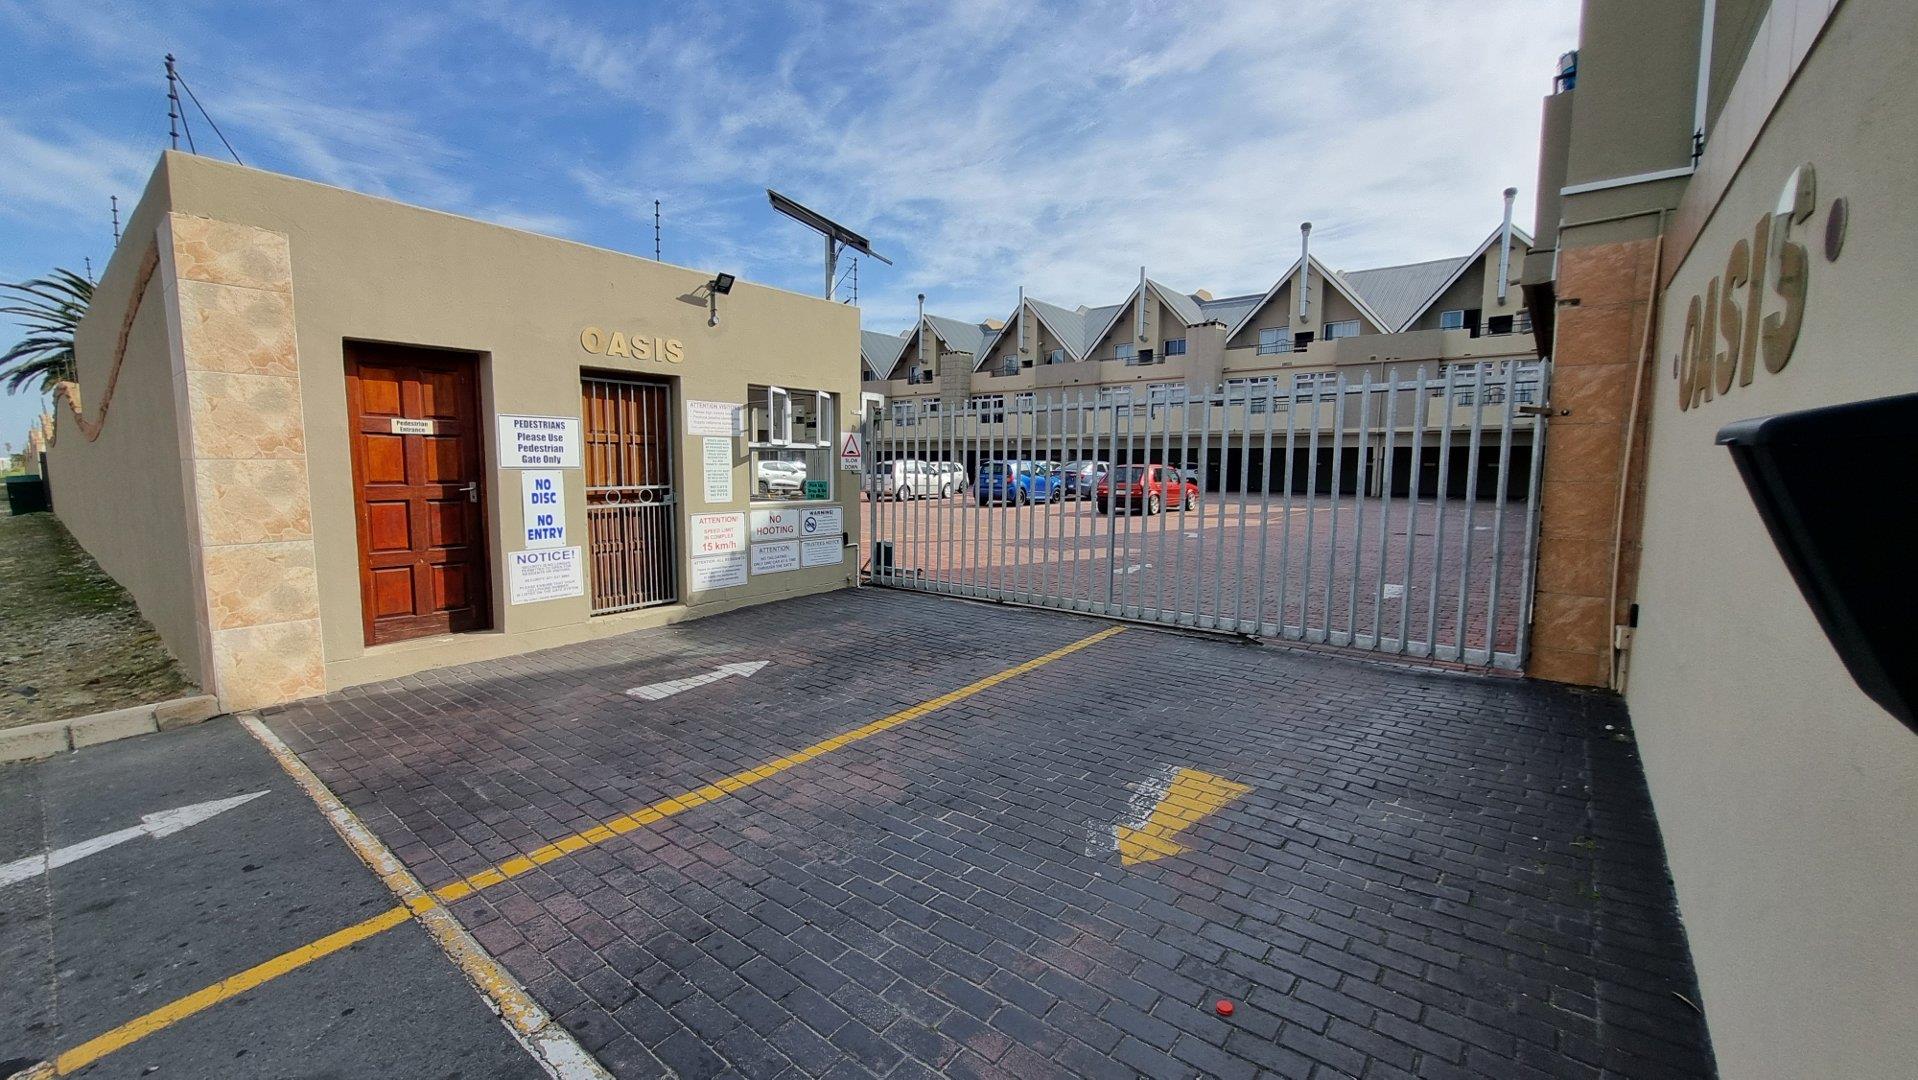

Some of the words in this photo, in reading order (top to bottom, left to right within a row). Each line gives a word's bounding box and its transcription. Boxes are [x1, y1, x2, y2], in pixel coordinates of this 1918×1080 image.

[1679, 161, 1817, 412] OASIS
[580, 325, 685, 364] OASIS
[514, 419, 566, 430] PEDESTRIANS
[517, 432, 546, 442] Please
[548, 433, 563, 442] Use
[518, 444, 564, 453] Pedestrian
[522, 454, 541, 464] Gate
[543, 455, 561, 464] Only
[535, 479, 551, 490] NO
[531, 492, 556, 504] DISC
[537, 514, 553, 526] NO
[769, 515, 782, 523] NO
[527, 527, 563, 540] ENTRY
[756, 525, 794, 535] HOOTING
[702, 543, 713, 551] 15
[715, 541, 737, 550] km/h
[517, 550, 575, 564] NOTICE!
